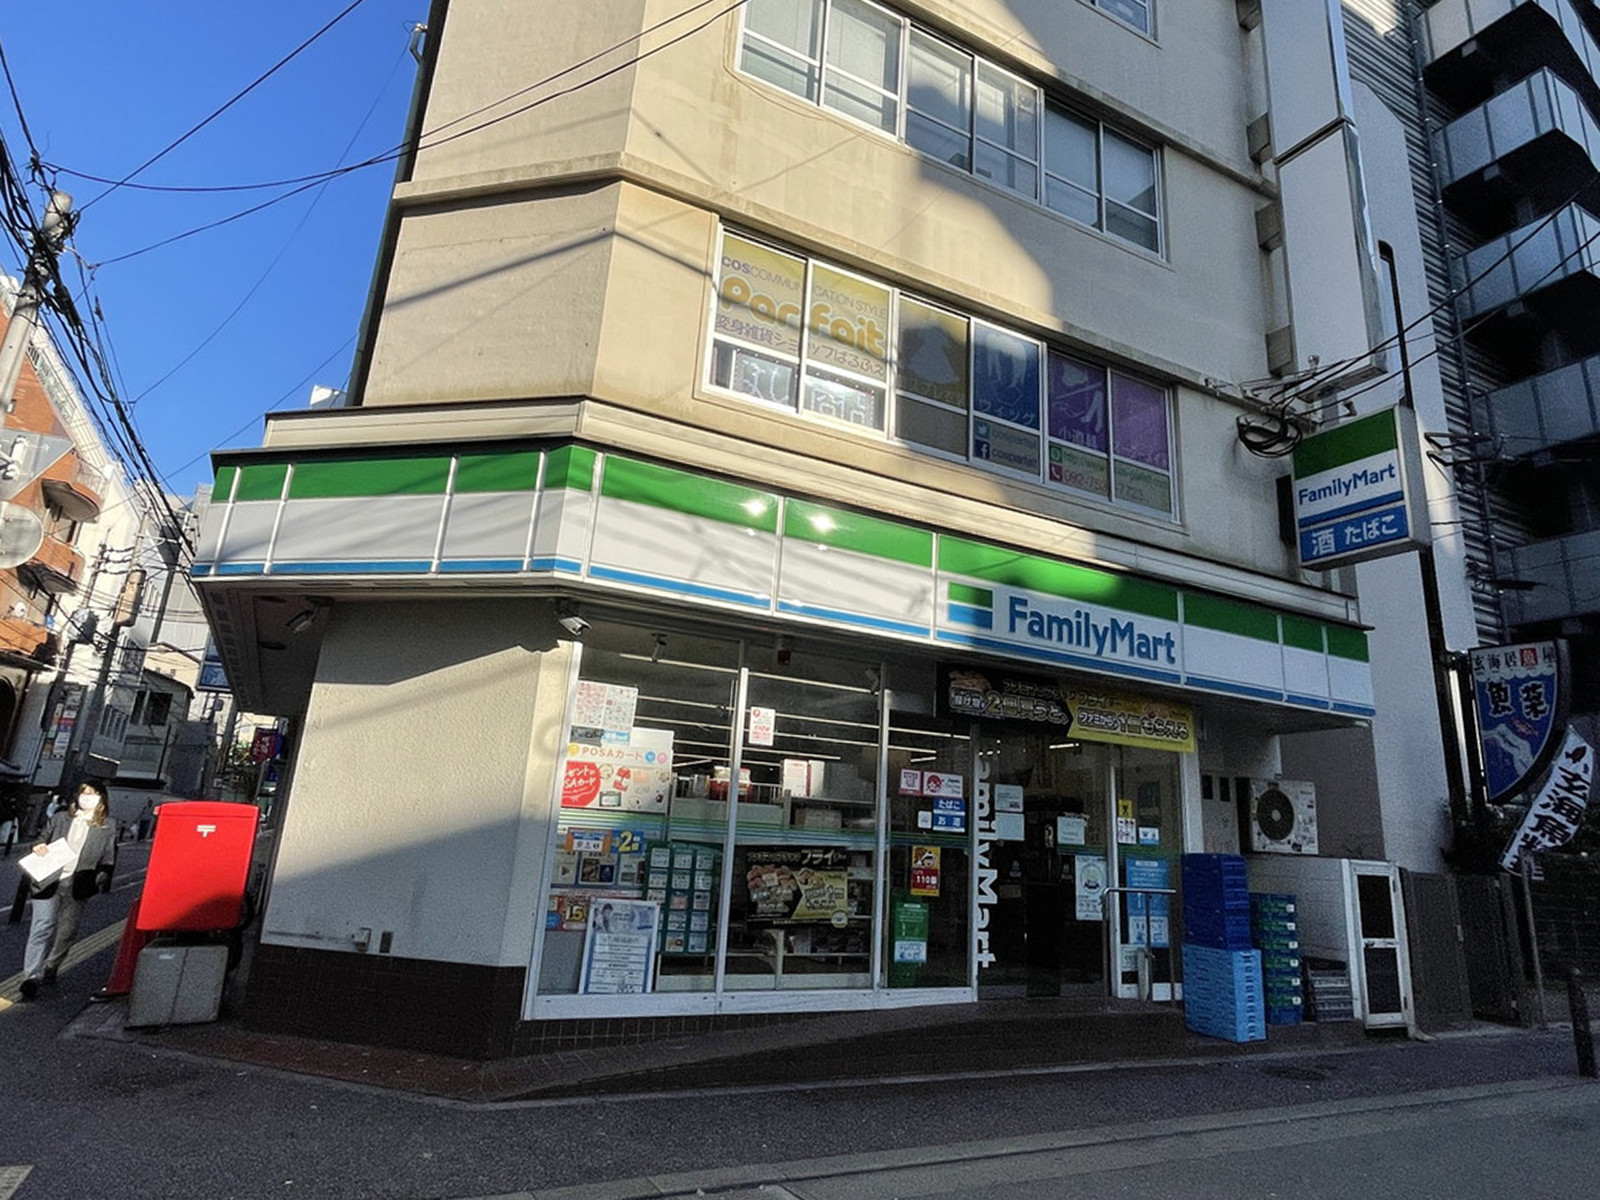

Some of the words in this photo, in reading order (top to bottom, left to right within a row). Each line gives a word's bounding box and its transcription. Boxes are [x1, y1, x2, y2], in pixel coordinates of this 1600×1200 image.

[1298, 463, 1396, 505] FamilyMart
[1311, 528, 1336, 556] 酒
[1344, 514, 1398, 545] たばこ
[1009, 595, 1176, 665] FamilyMart
[938, 799, 961, 810] たばこ
